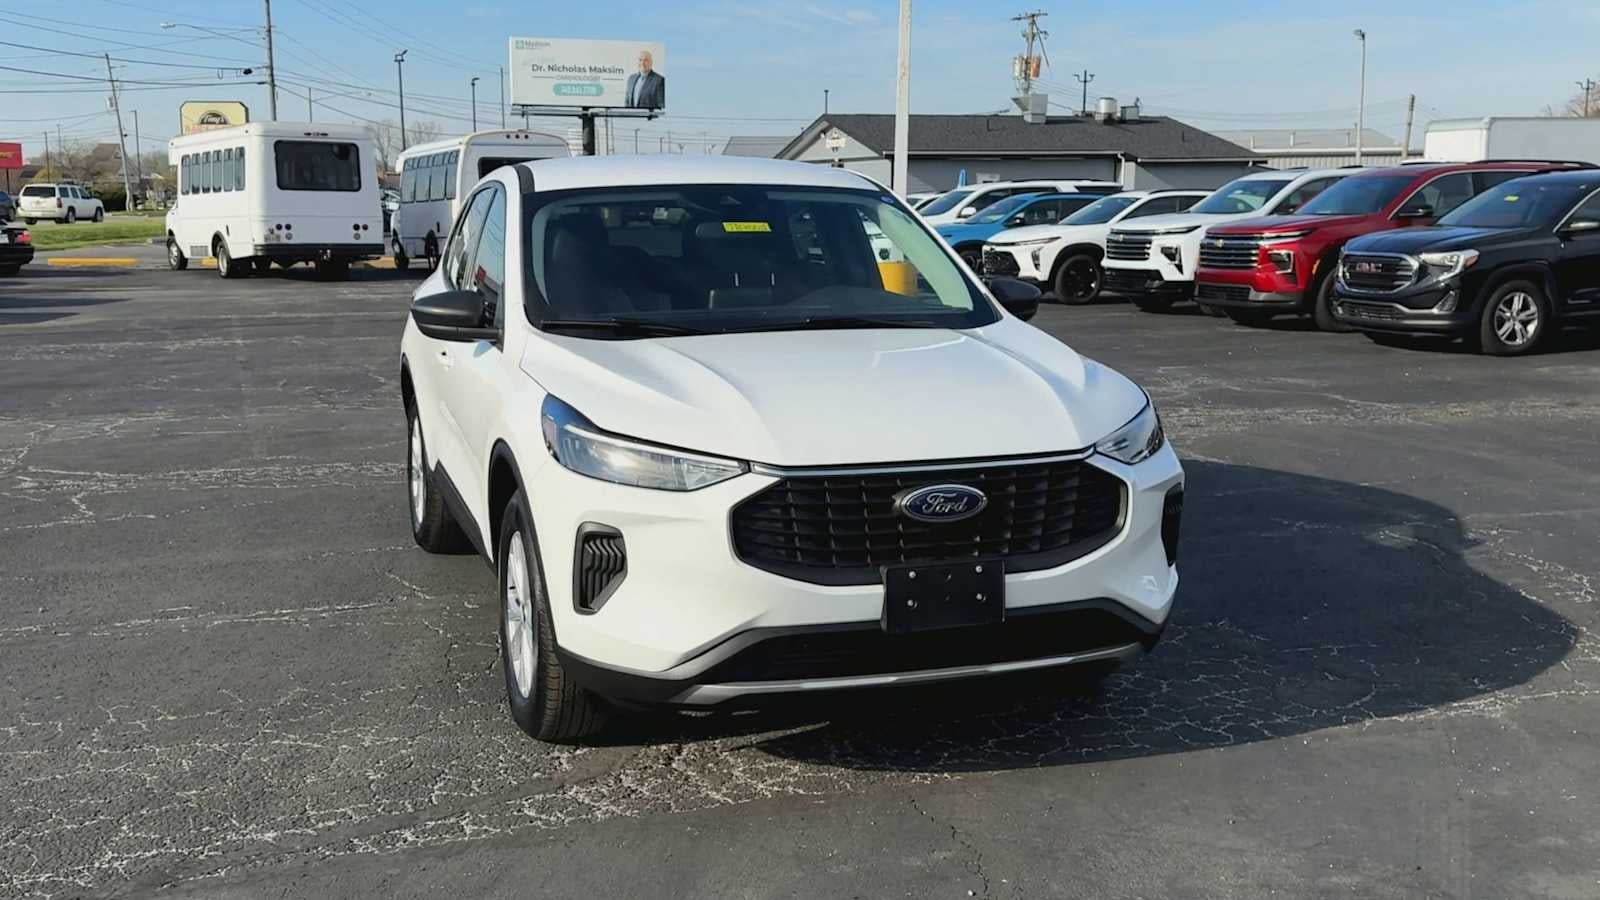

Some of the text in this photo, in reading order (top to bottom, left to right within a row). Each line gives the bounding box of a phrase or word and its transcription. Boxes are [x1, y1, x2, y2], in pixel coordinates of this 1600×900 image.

[532, 64, 625, 75] Dr. Nicholas Maksim
[922, 493, 968, 514] Ford
